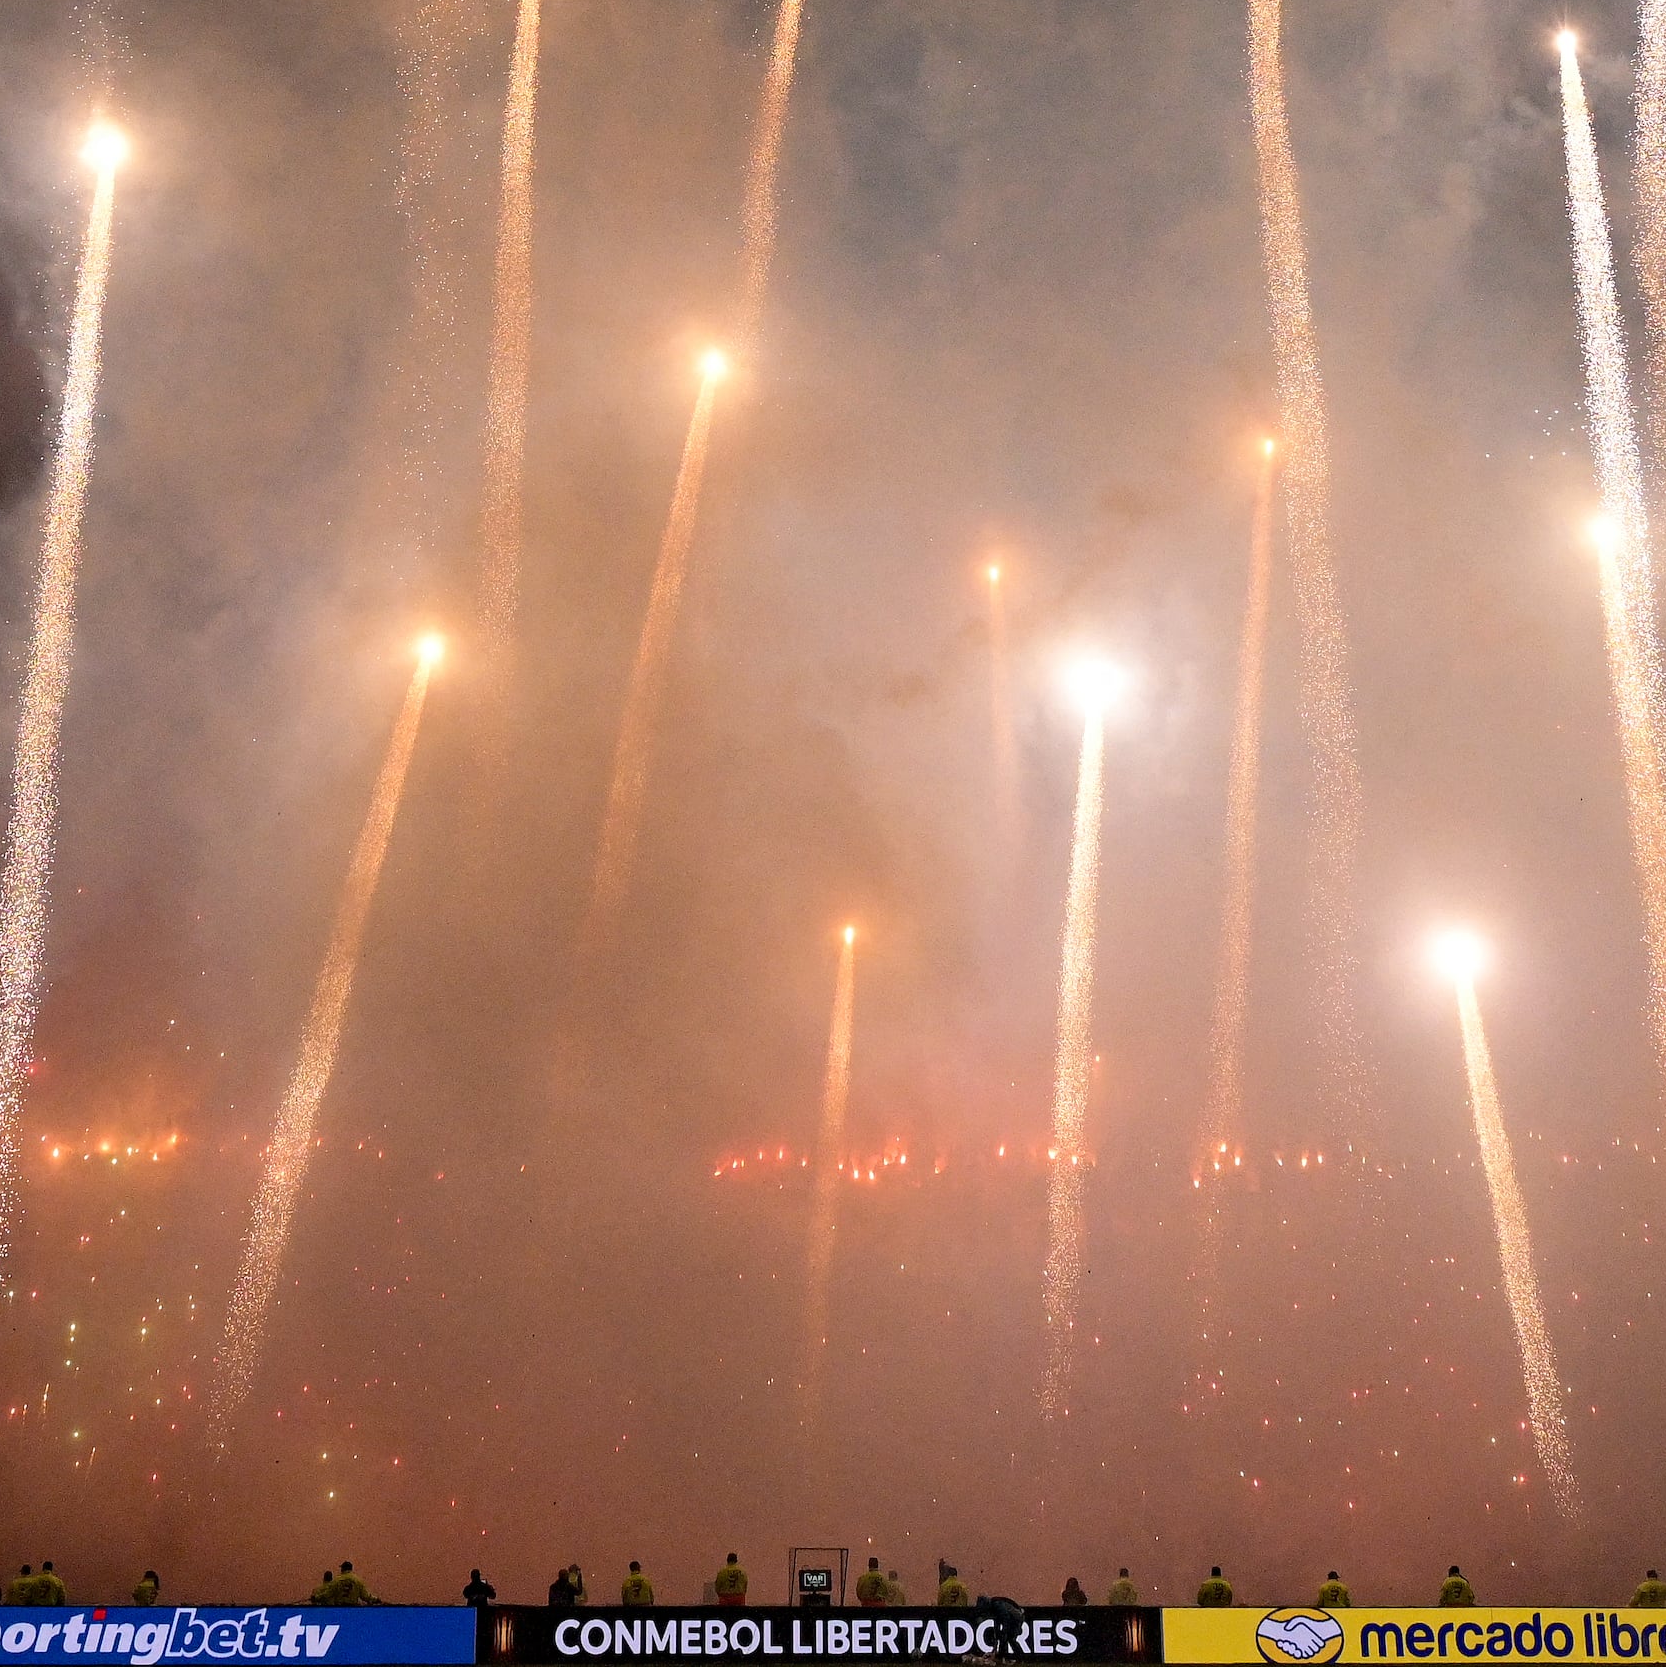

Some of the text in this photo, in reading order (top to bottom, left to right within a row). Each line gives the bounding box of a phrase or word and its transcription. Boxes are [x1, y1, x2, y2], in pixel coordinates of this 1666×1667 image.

[806, 1574, 824, 1582] VAR
[555, 1618, 784, 1655] CONMEBOL
[1360, 1612, 1574, 1658] mercado
